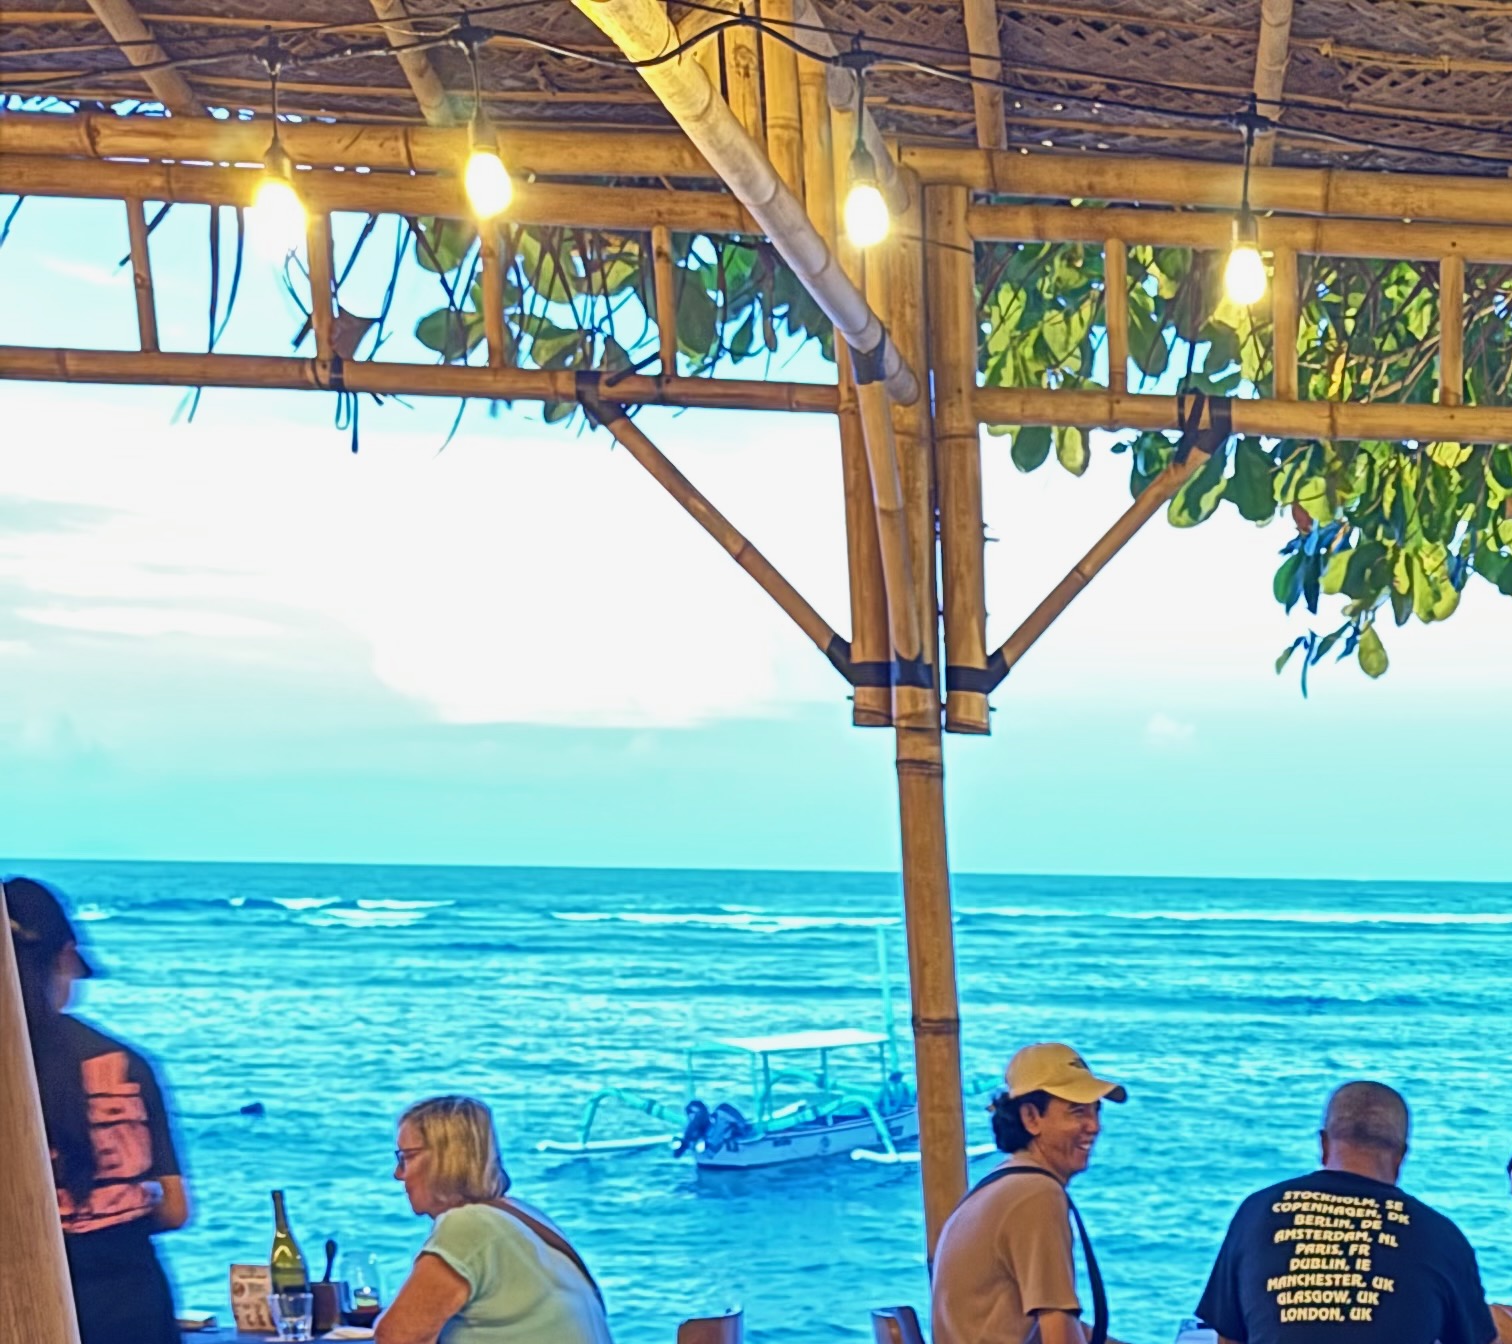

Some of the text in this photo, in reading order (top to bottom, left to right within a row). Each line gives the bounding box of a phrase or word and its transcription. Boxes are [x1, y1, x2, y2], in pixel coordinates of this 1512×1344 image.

[1385, 1200, 1403, 1212] SE
[1294, 1214, 1382, 1230] BERLIN, DE
[1387, 1212, 1410, 1224] DK
[1274, 1228, 1398, 1248] AMSTERDAM, NL
[1295, 1243, 1370, 1256] PARIS, FR
[1290, 1258, 1372, 1271] DUBLIN, IE
[1267, 1274, 1394, 1292] MANCHESTER, UK
[1276, 1290, 1379, 1306] GLASGOW, UK
[1280, 1307, 1372, 1322] LONDON, UK
